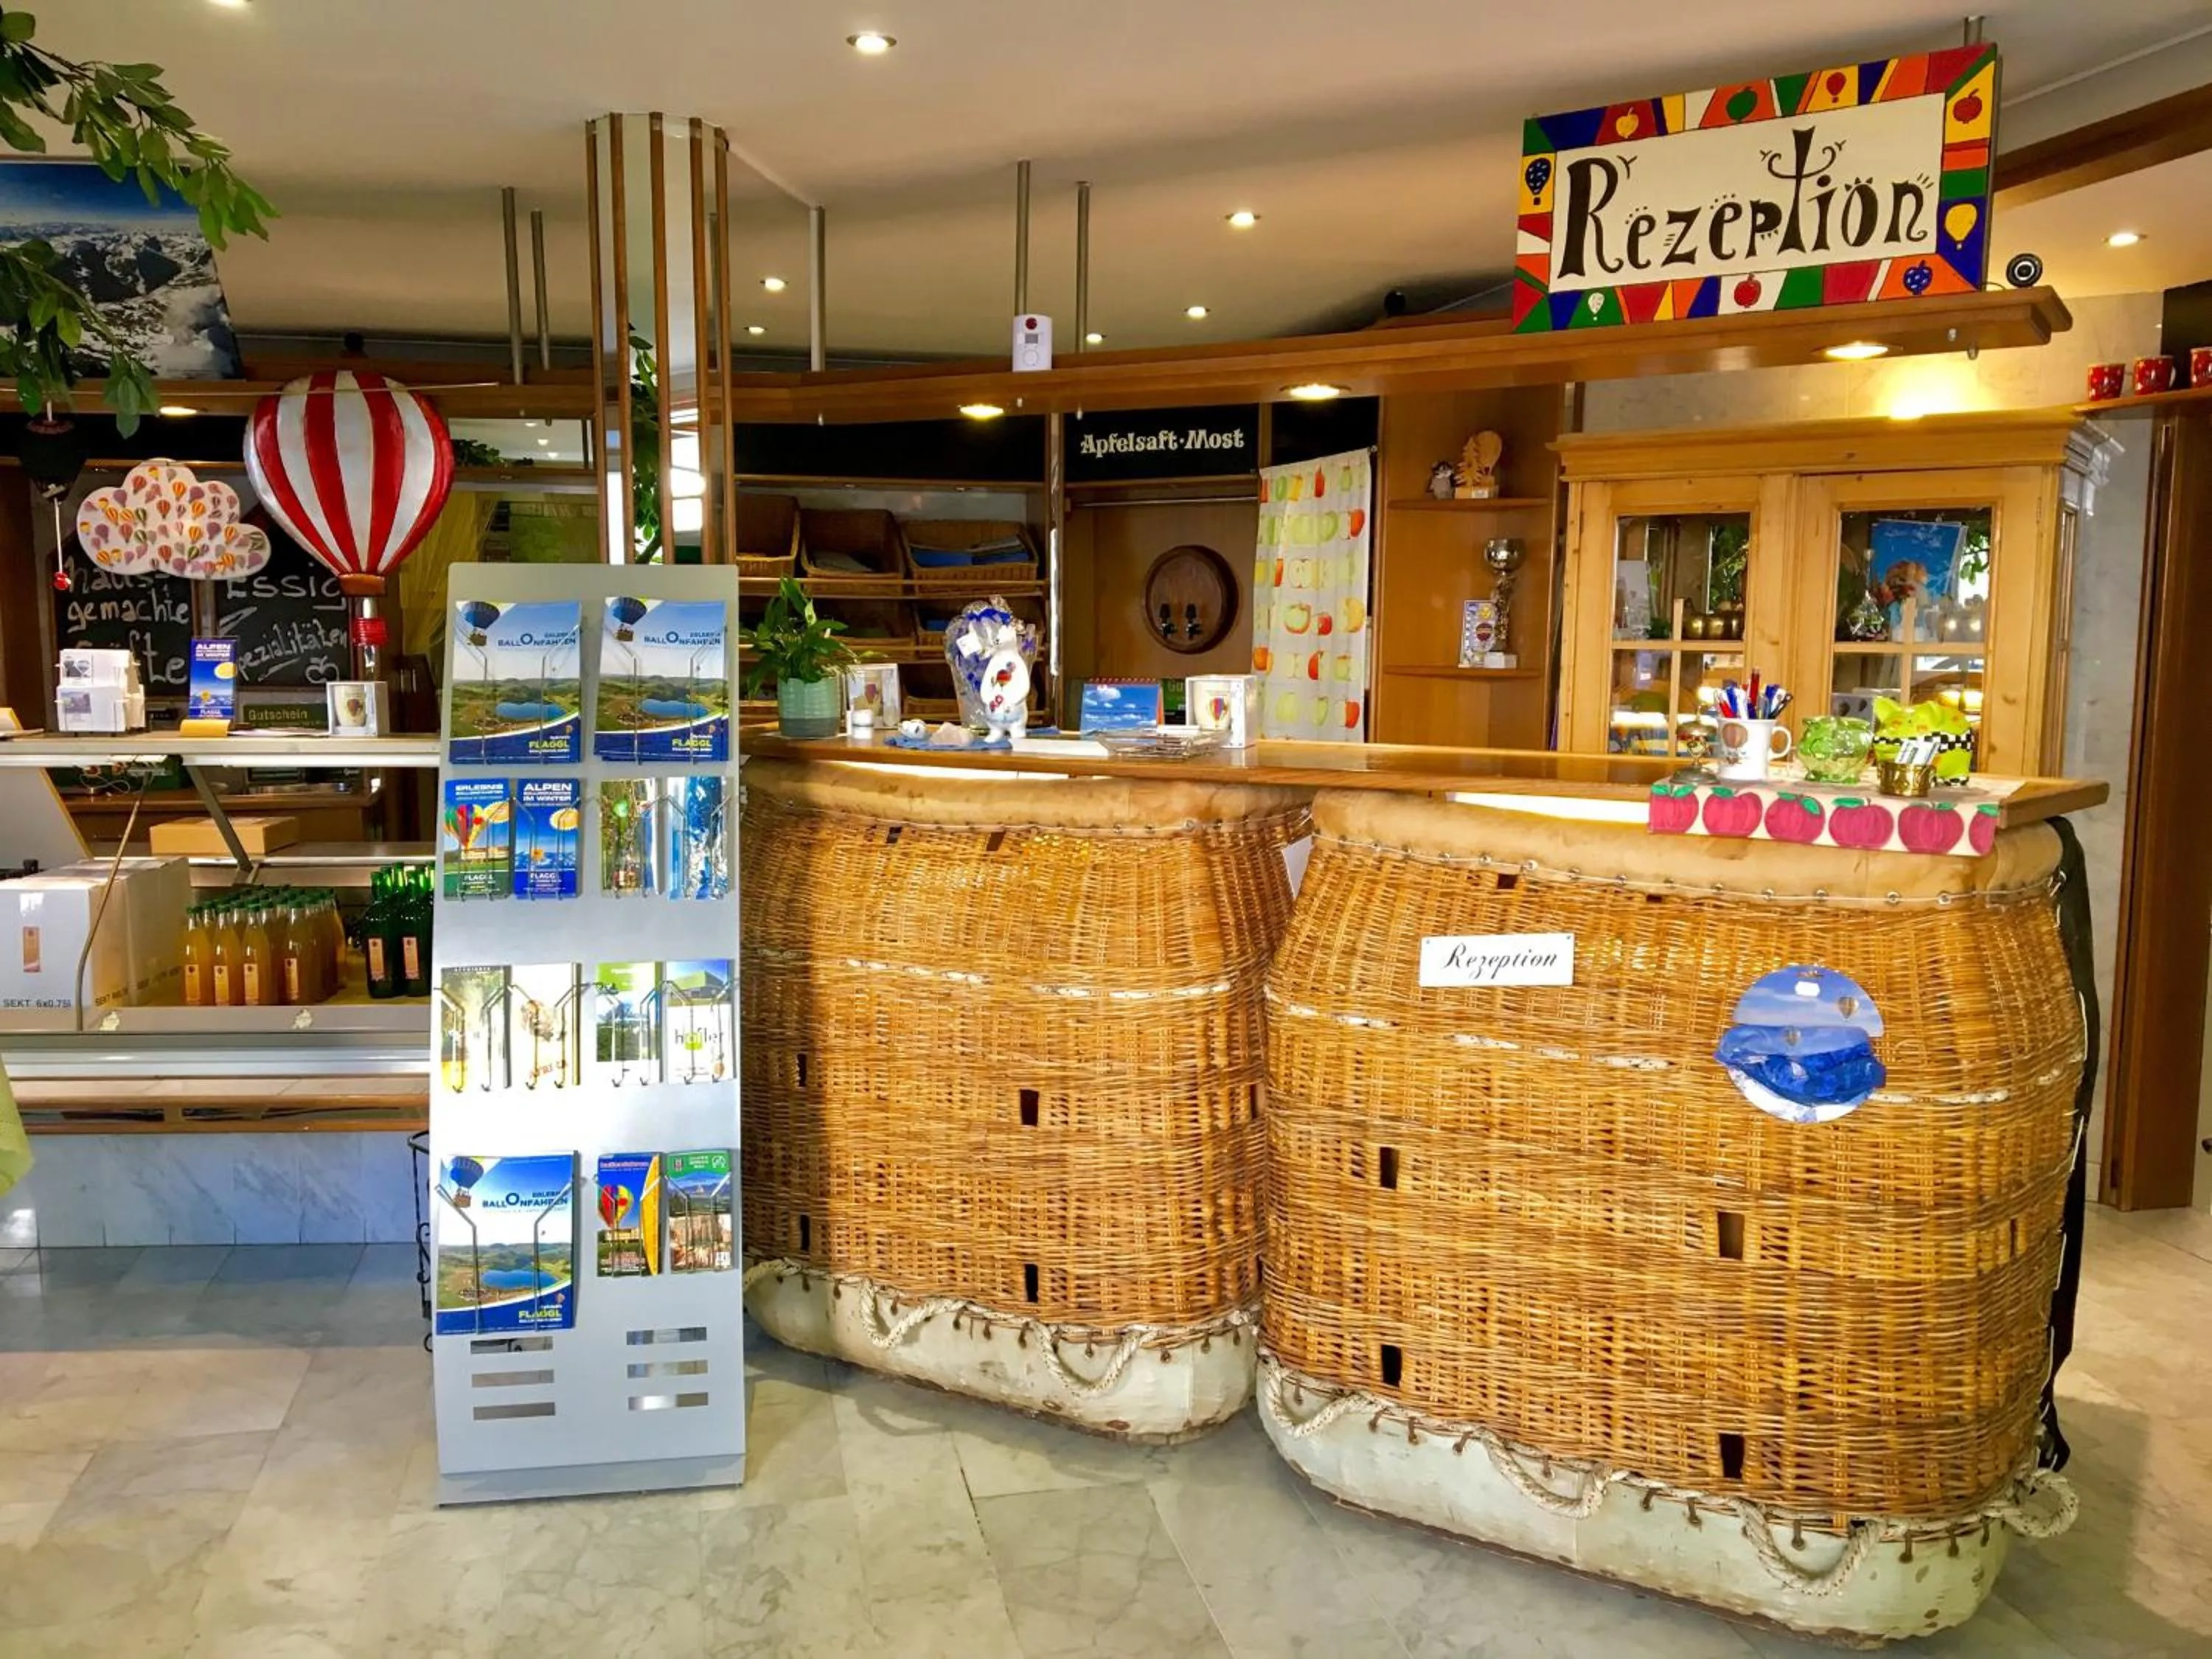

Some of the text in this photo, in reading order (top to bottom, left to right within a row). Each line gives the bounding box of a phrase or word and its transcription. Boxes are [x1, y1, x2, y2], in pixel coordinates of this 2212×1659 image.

[1557, 126, 1935, 279] Rezeption
[524, 783, 572, 791] ALPEN
[1443, 942, 1558, 979] Rezeption
[3, 998, 31, 1007] SEKT
